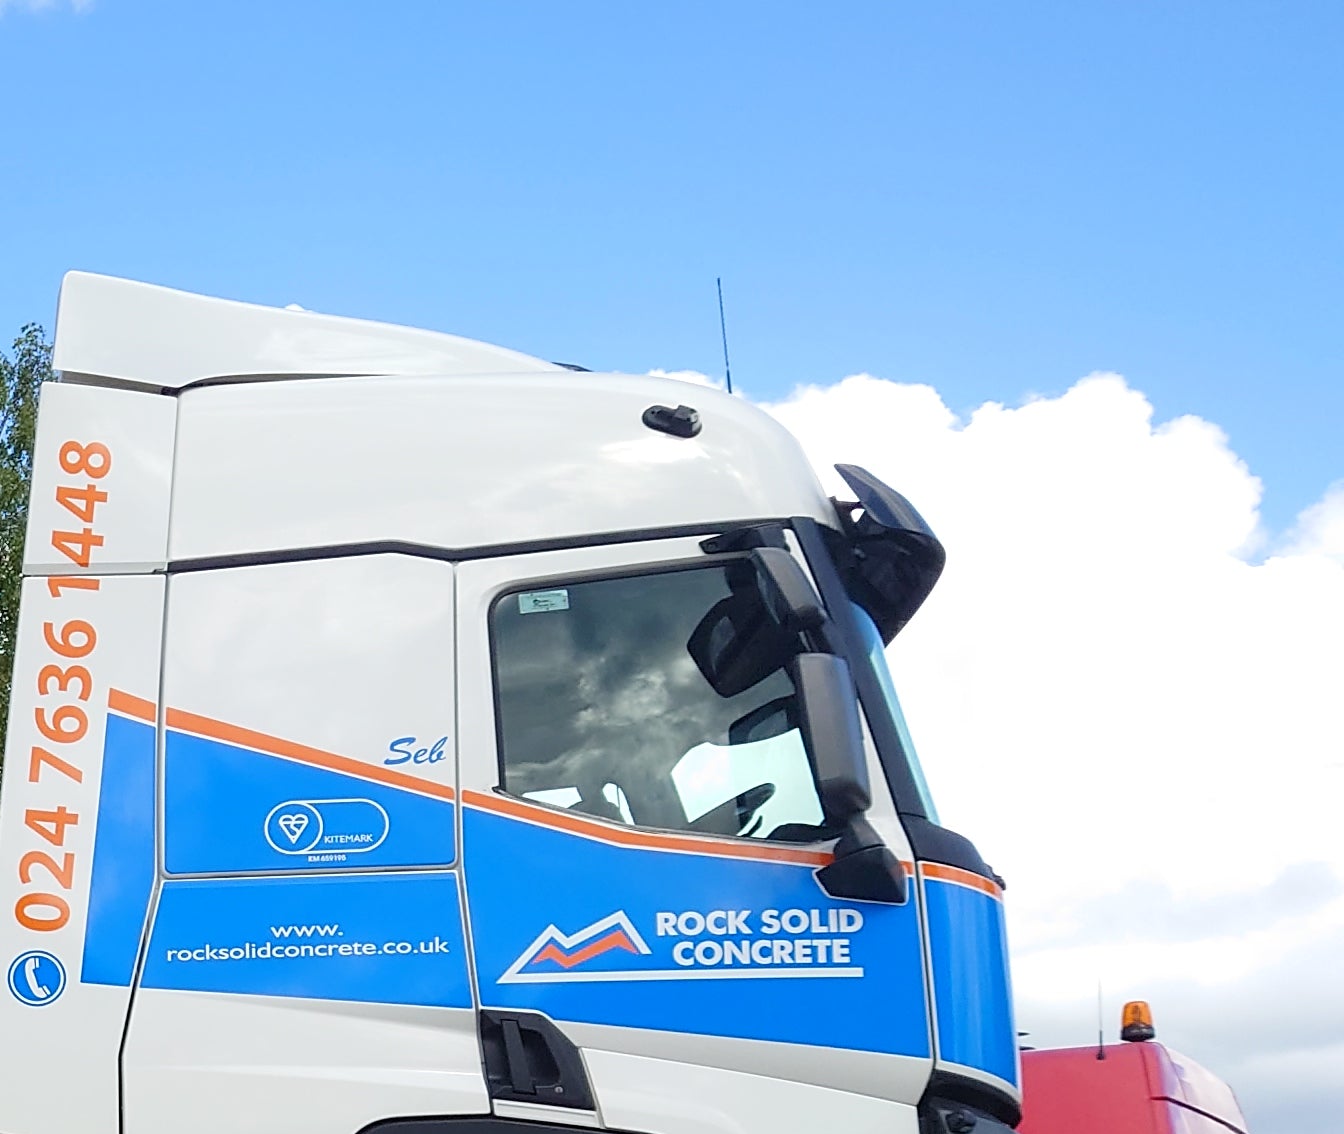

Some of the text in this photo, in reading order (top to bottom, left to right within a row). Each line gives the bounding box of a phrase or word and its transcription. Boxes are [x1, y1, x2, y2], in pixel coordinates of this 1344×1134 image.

[15, 440, 112, 932] 024 7636 1448
[384, 736, 448, 765] Seb
[324, 834, 374, 844] KITEMARK
[270, 924, 344, 938] www.
[656, 908, 864, 937] ROCK SOLID
[166, 937, 449, 962] rocksolidconcrete.co.uk
[672, 938, 851, 966] CONCRETE
